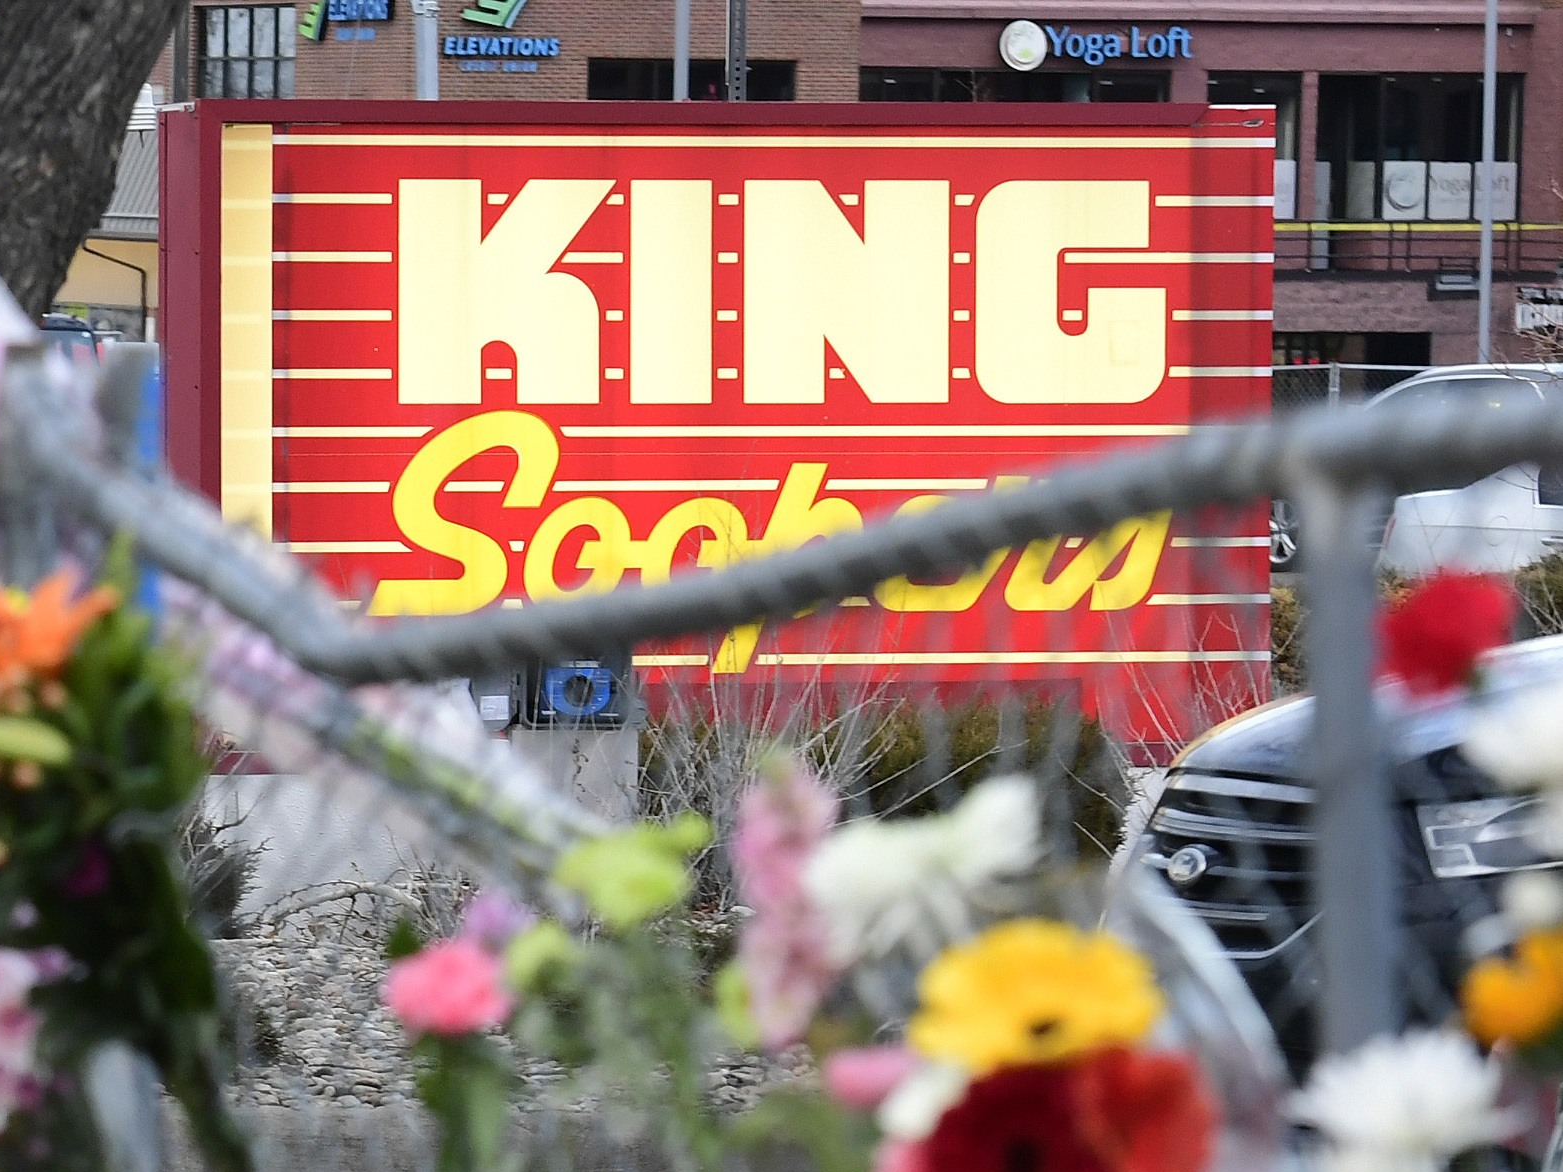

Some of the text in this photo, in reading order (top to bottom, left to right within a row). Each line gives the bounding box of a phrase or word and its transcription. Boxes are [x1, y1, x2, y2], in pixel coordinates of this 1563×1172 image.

[444, 36, 560, 56] ELEVATIONS
[1045, 25, 1193, 66] Yoga Loft
[397, 179, 1167, 405] KING
